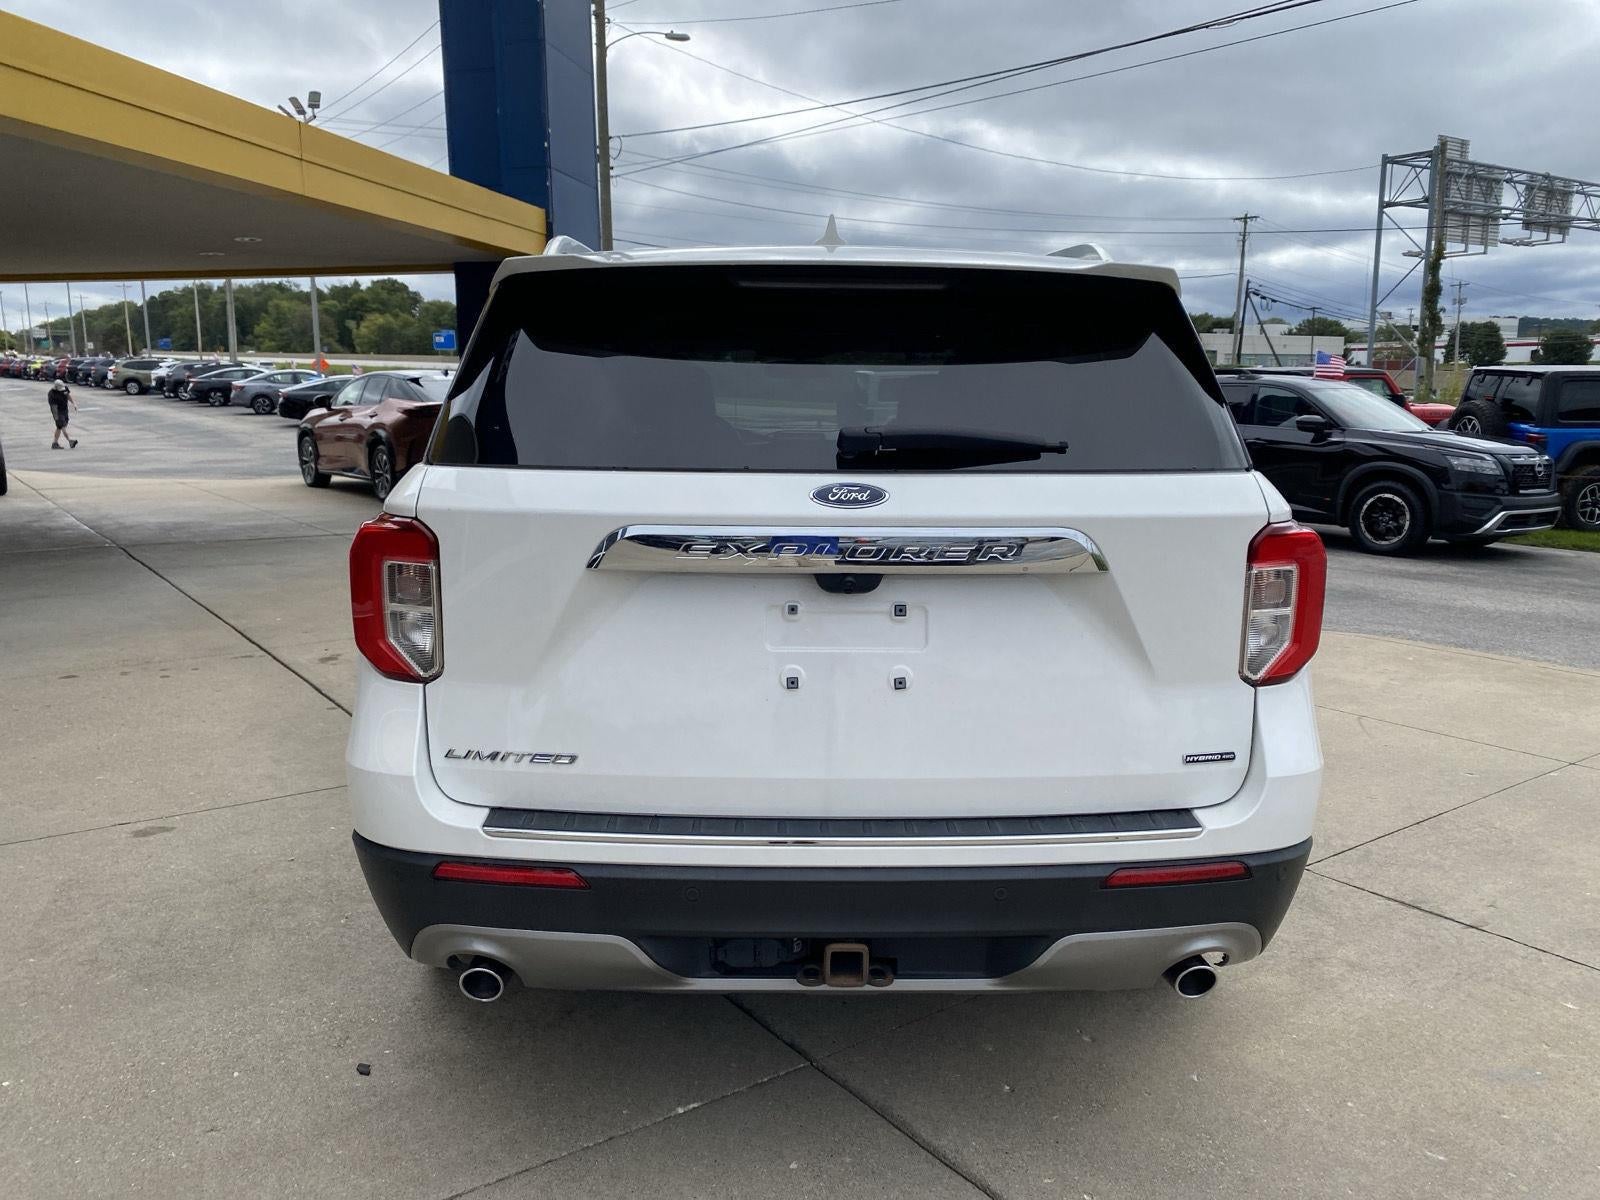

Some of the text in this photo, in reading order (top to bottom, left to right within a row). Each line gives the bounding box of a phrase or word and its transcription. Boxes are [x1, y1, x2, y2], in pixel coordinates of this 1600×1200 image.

[828, 486, 871, 501] Ford
[675, 540, 1023, 564] EXPLORER
[444, 748, 578, 765] LIMITED
[1186, 754, 1221, 762] HYBRID
